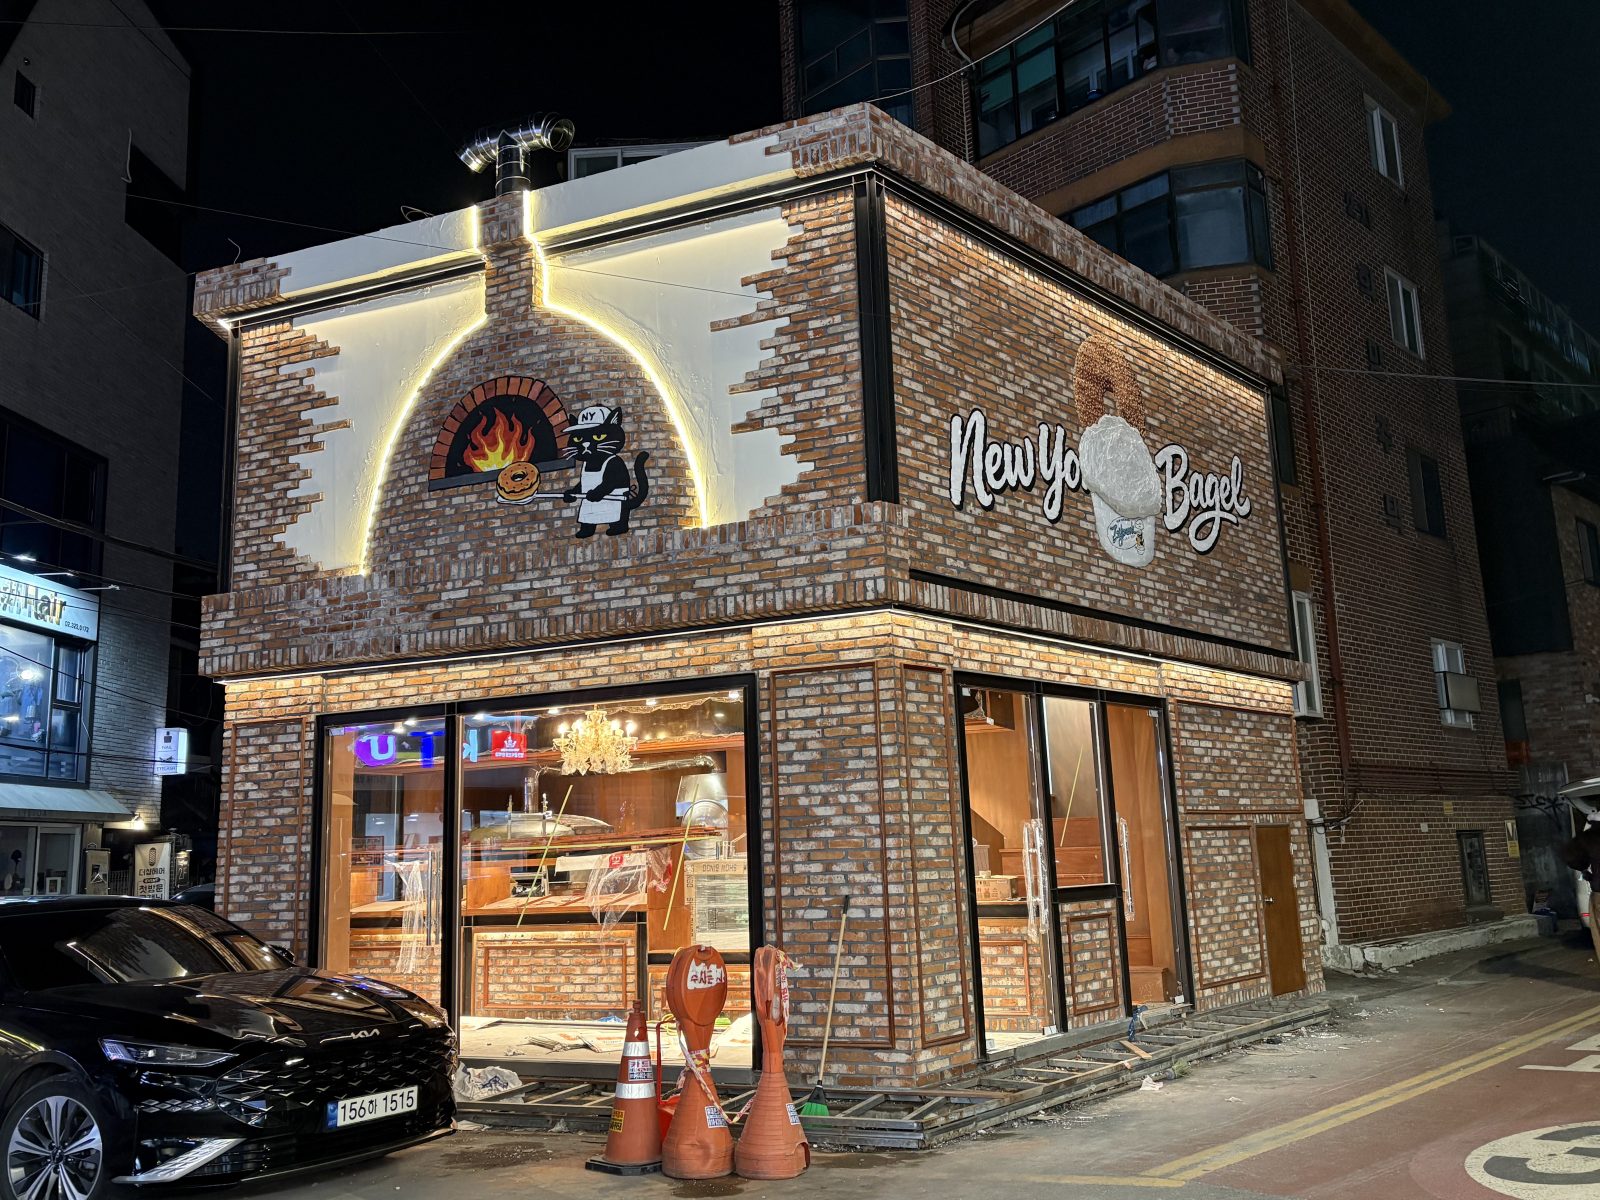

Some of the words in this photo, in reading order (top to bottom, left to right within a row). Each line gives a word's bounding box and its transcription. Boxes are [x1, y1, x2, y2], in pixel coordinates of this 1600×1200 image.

[581, 411, 596, 423] NY
[949, 407, 1037, 511] New
[1037, 421, 1091, 524] Yo
[1154, 442, 1252, 555] Bagel
[25, 583, 67, 626] Hair
[138, 883, 164, 894] 첫방문
[351, 1028, 381, 1040] KIA
[340, 1099, 378, 1122] 156하
[383, 1090, 415, 1113] 1515
